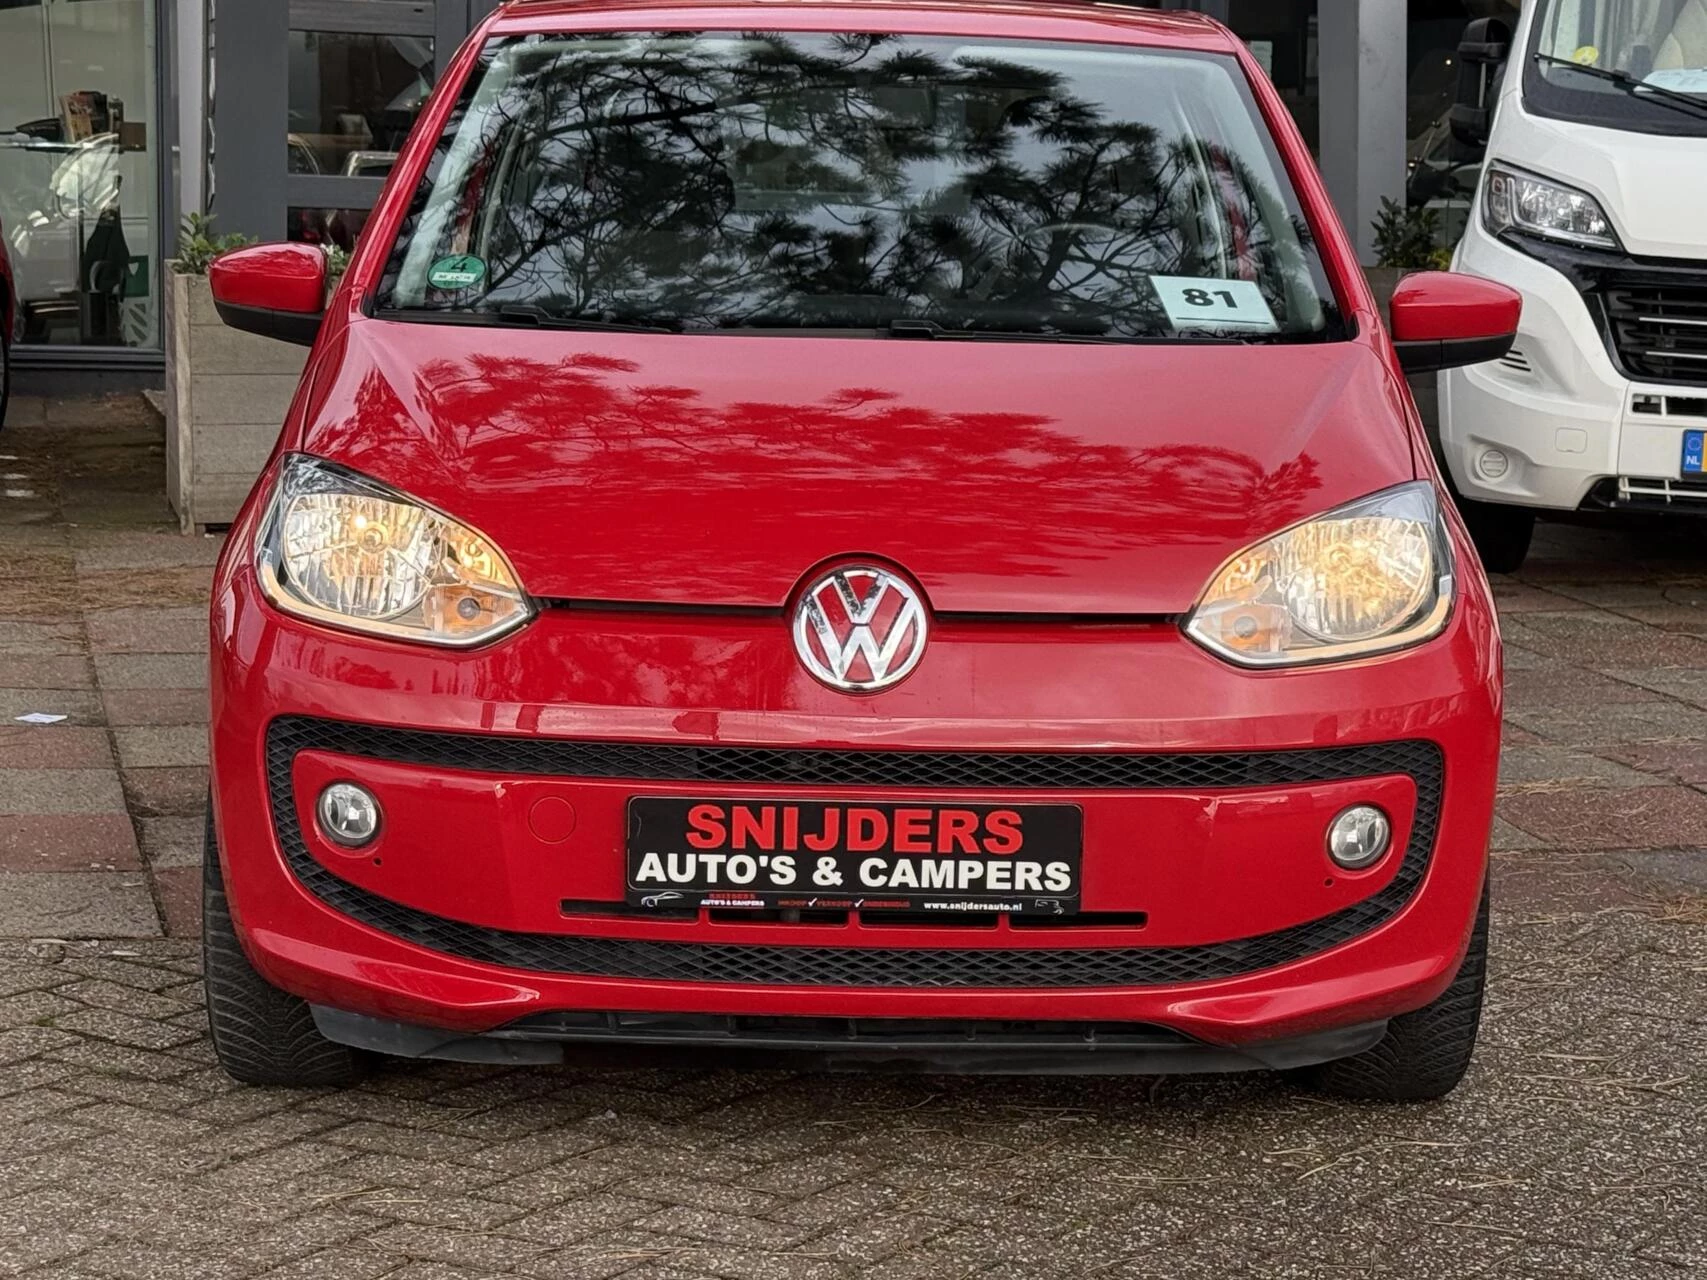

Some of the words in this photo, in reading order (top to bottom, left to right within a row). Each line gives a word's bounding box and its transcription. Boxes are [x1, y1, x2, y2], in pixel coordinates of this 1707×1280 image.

[451, 256, 469, 272] 4
[1182, 288, 1238, 308] 81
[1686, 455, 1700, 465] NL
[793, 563, 928, 692] VW
[686, 804, 1024, 854] SNIJDERS
[636, 853, 797, 886] AUTO'S
[812, 857, 844, 887] &
[859, 857, 1072, 892] CAMPERS
[923, 902, 1023, 912] www.snijdersauto.nl
